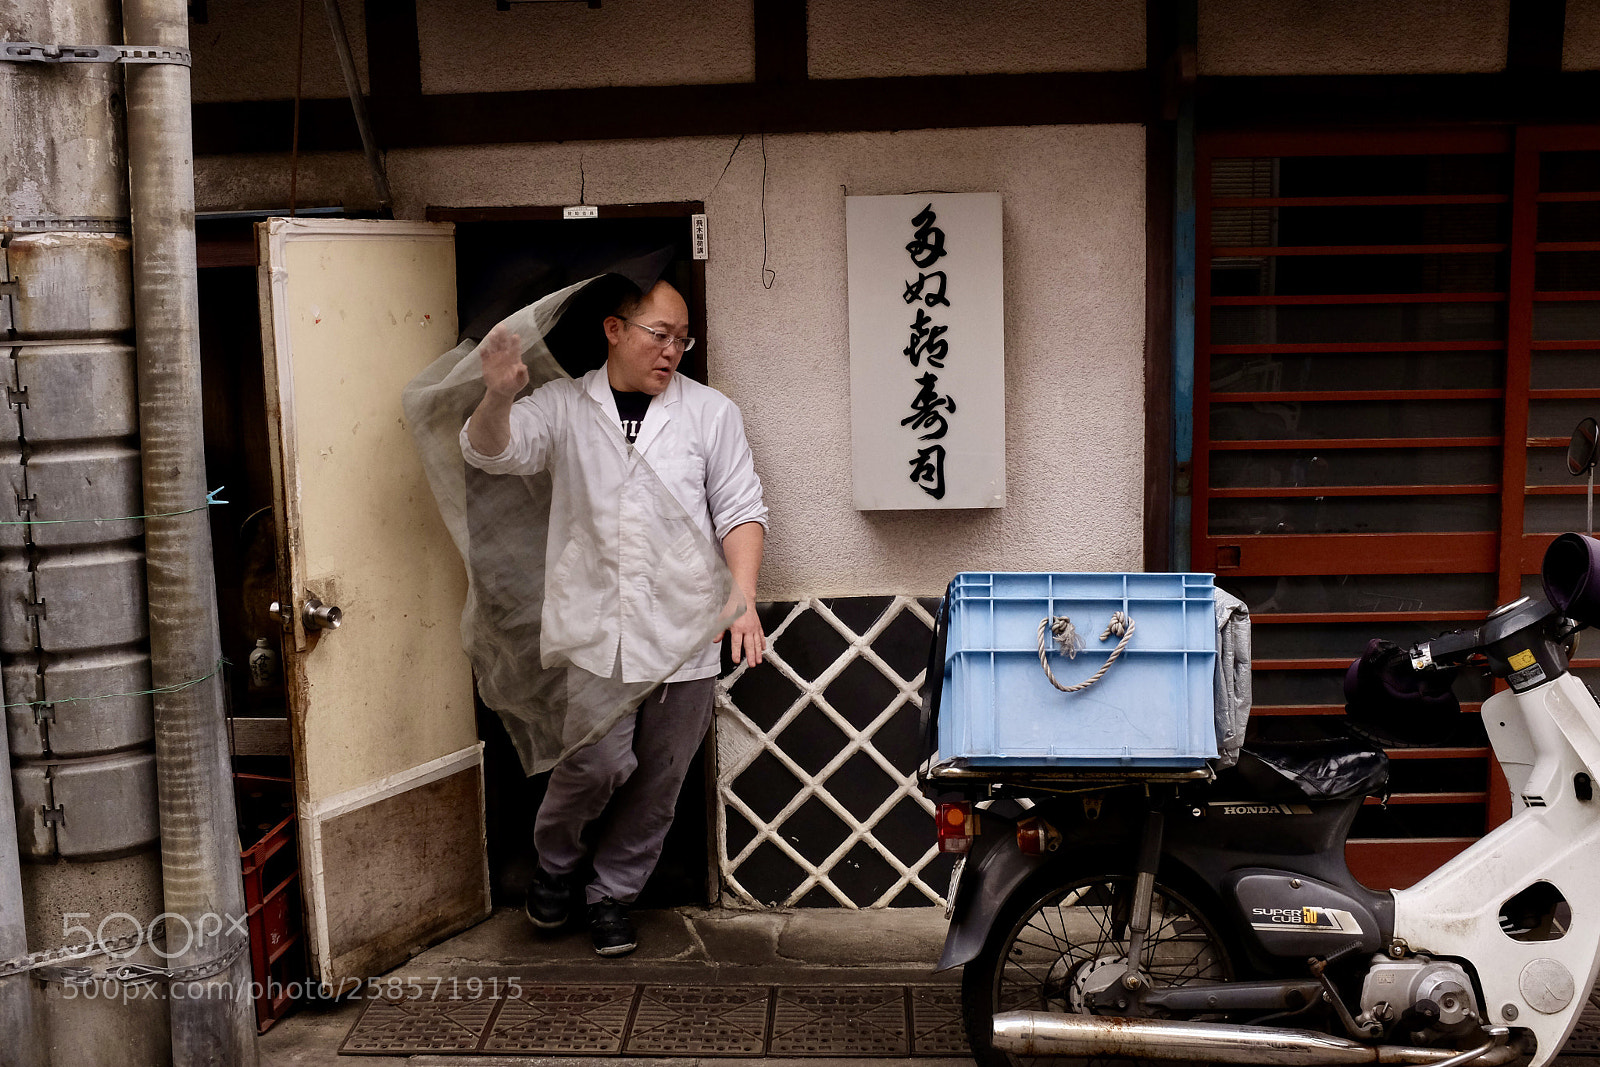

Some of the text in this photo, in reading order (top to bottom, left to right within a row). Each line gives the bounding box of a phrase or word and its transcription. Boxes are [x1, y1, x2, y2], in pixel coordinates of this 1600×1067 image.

[1223, 806, 1281, 815] HONDA
[1252, 908, 1302, 917] SUPER
[1271, 907, 1318, 924] CUB 50
